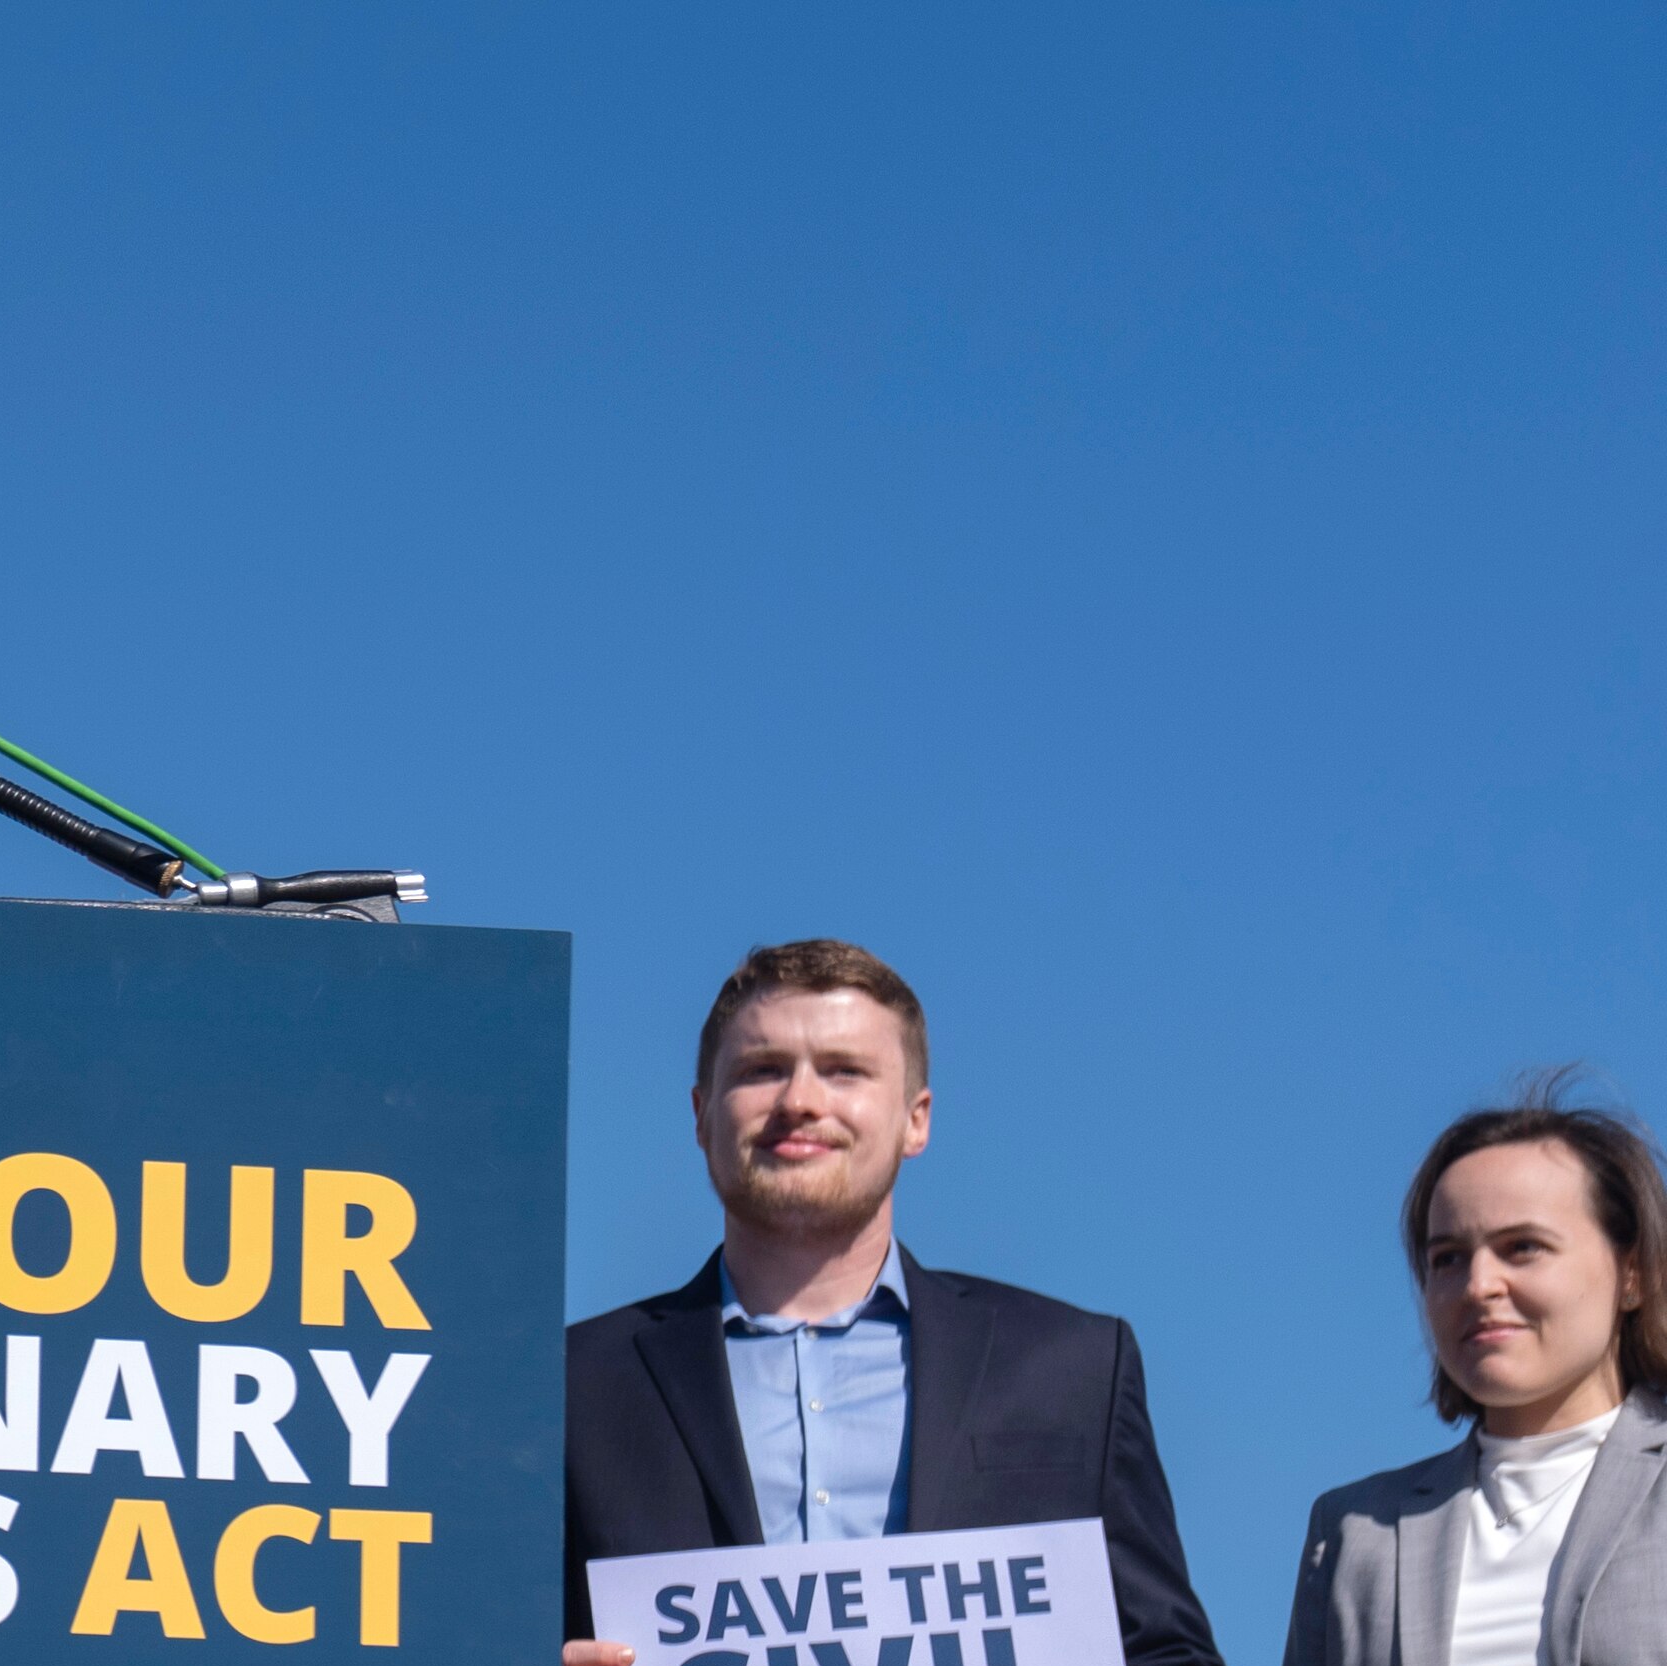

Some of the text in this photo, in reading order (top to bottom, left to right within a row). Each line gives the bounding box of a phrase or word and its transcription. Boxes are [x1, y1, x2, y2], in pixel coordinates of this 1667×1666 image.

[70, 1498, 433, 1648] ACT
[654, 1555, 1052, 1646] SAVE THE
